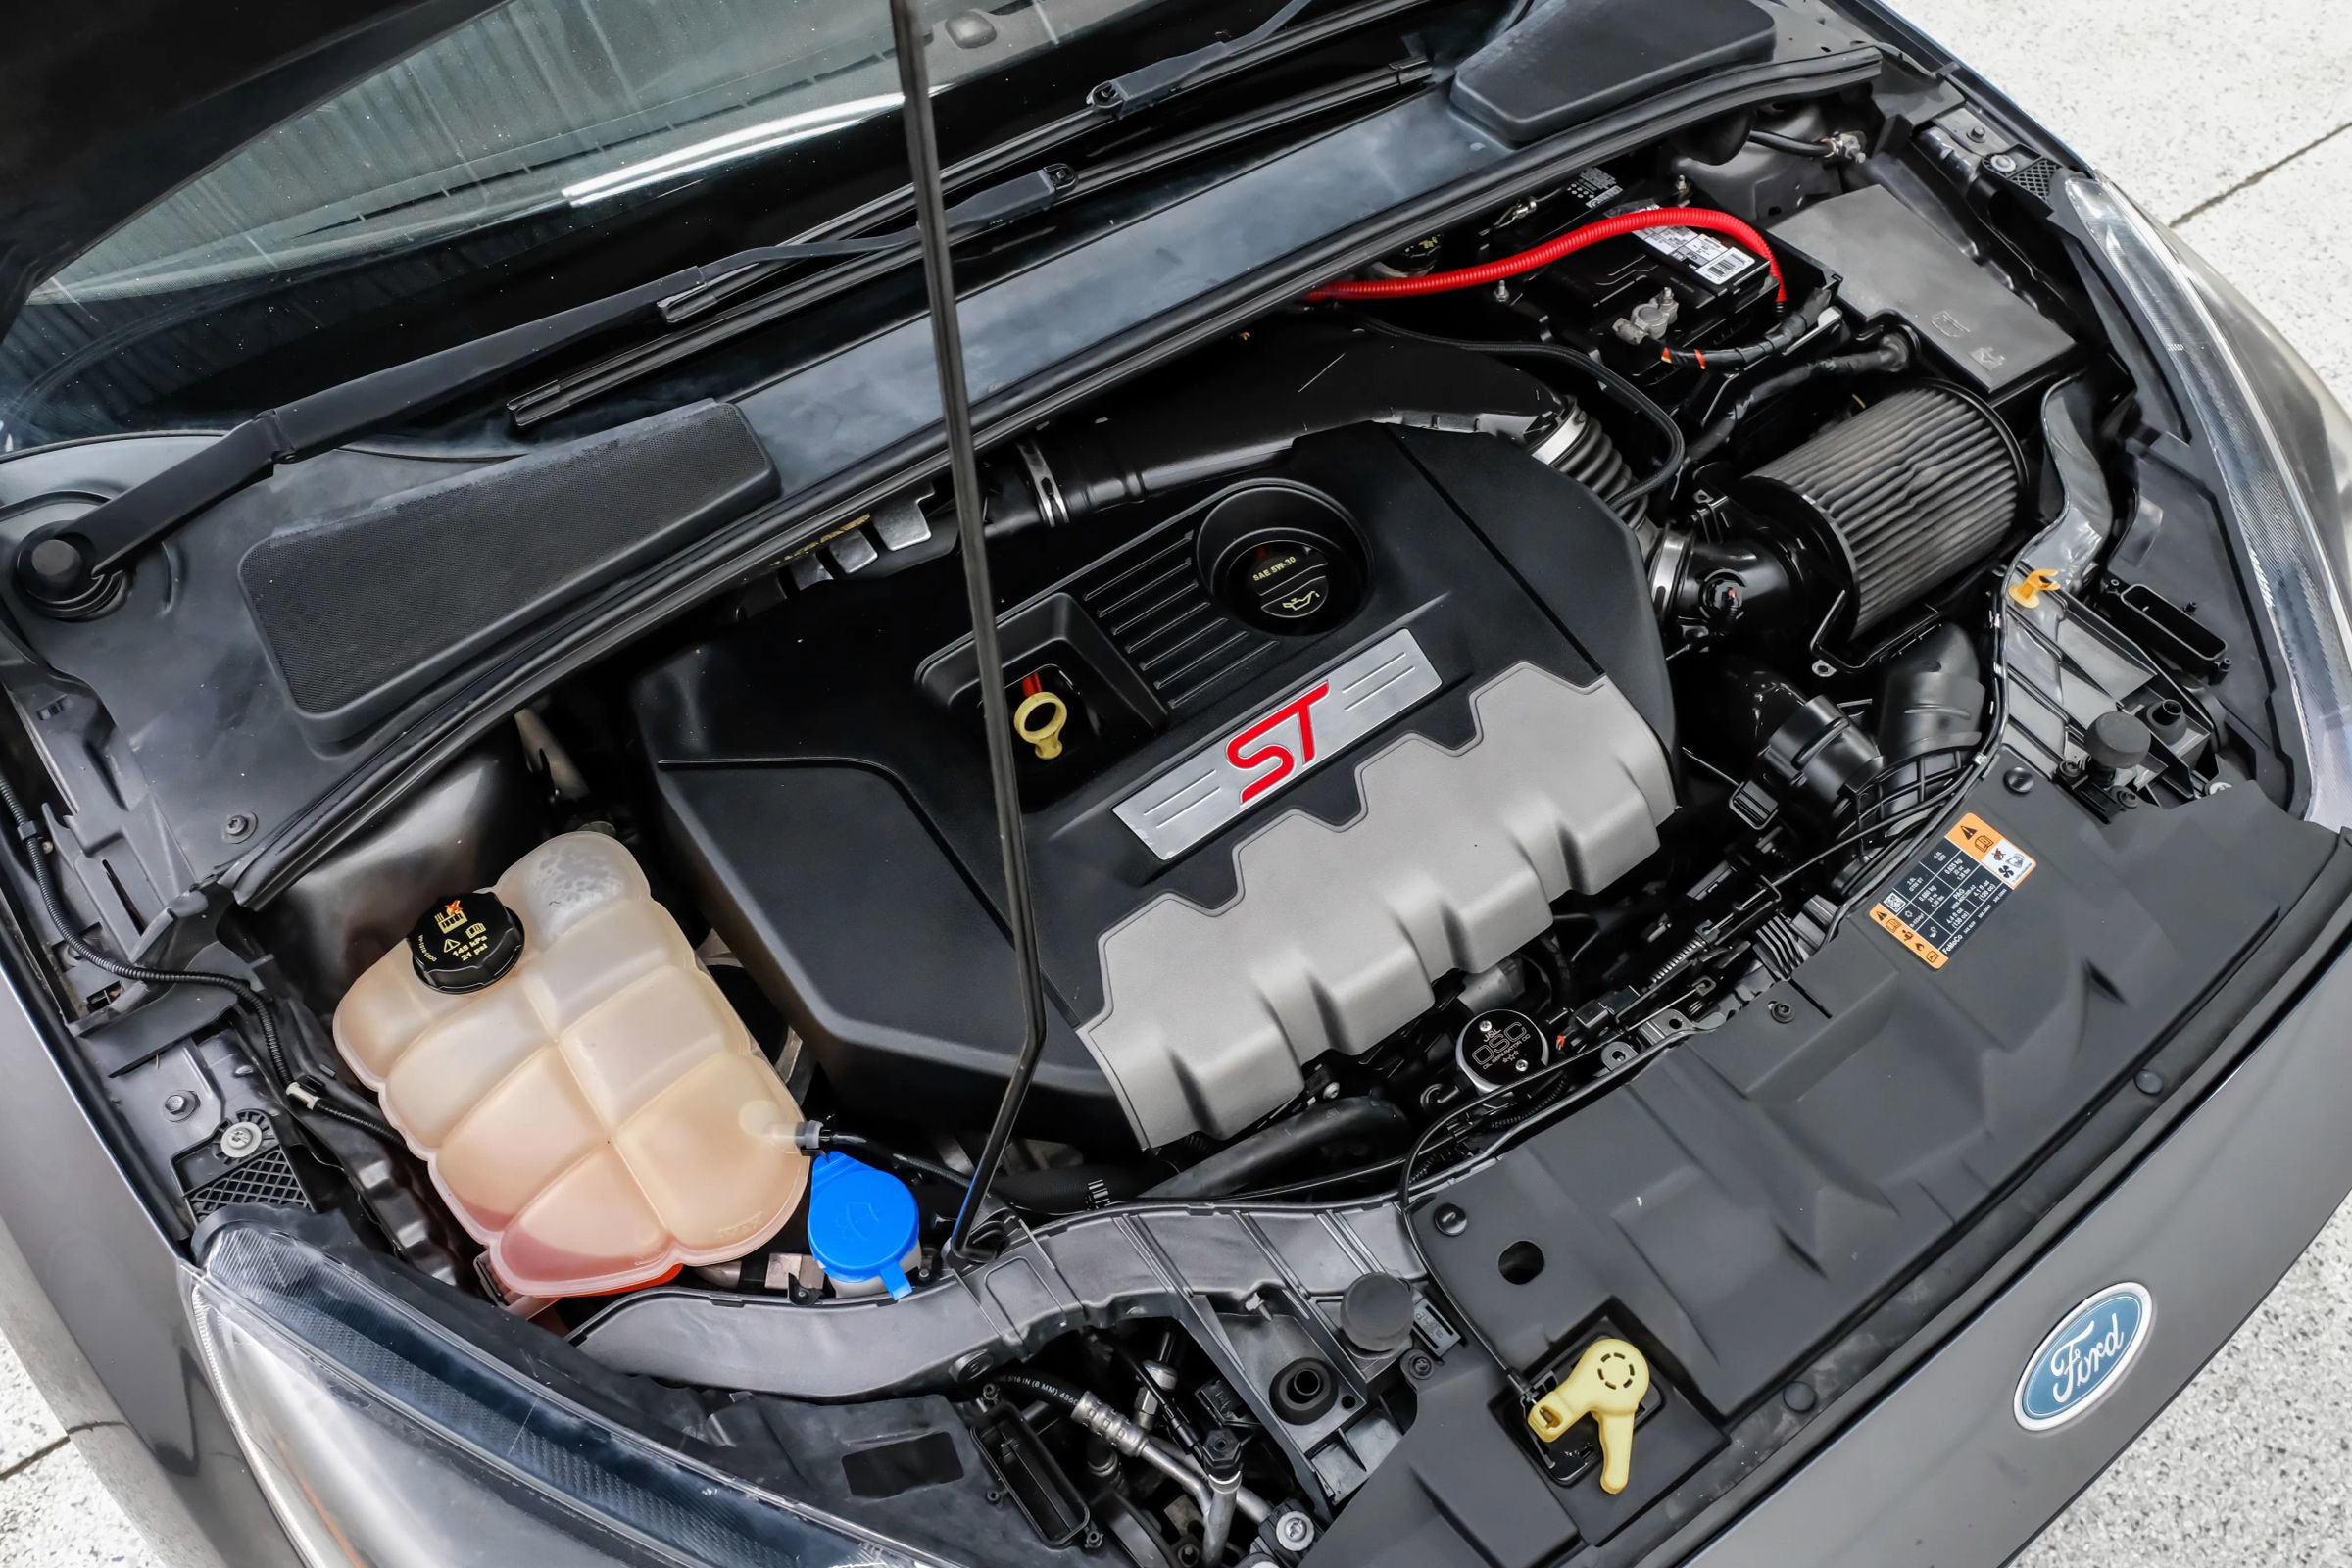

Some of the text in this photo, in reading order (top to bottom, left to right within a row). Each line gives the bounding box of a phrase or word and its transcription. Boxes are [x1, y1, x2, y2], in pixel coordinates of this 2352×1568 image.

[1252, 556, 1297, 581] SAE 5W-30
[1225, 681, 1330, 805] ST
[1953, 888, 1965, 900] PAG
[1978, 890, 1989, 902] (120
[1951, 917, 1963, 929] (130
[452, 935, 488, 956] 145 kPa
[461, 943, 488, 961] 21 psi
[1942, 934, 1963, 954] FoMoCo
[1472, 1021, 1527, 1065] OSC
[1483, 1028, 1502, 1042] J&L
[1492, 1041, 1522, 1064] SEPARATOR
[2050, 1313, 2125, 1403] Ford
[1041, 1383, 1058, 1396] MM)
